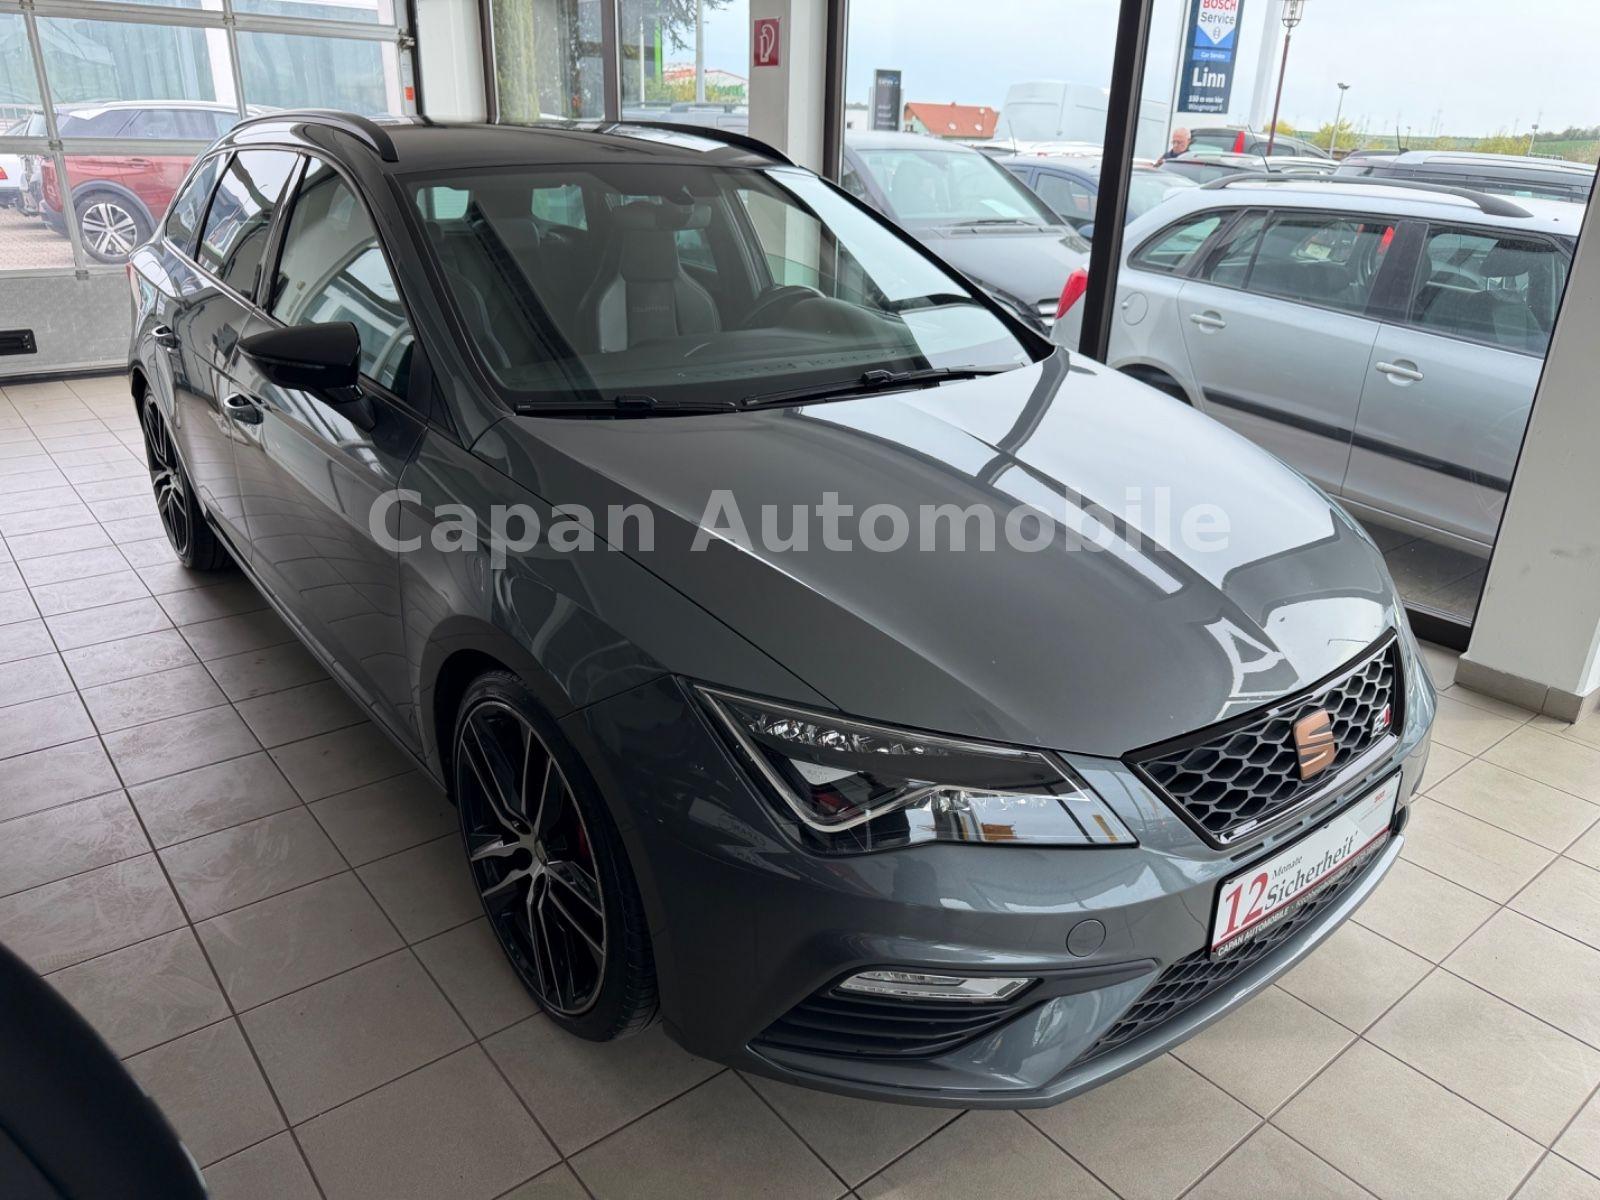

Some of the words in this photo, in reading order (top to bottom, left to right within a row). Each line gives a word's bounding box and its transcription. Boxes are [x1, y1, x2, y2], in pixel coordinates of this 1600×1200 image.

[1202, 0, 1237, 11] BOSCH
[1200, 12, 1236, 24] Service
[1192, 67, 1226, 88] Linn
[1220, 872, 1268, 939] 12
[1217, 933, 1245, 957] CAPAN
[1244, 906, 1289, 942] AUTOMOBILE
